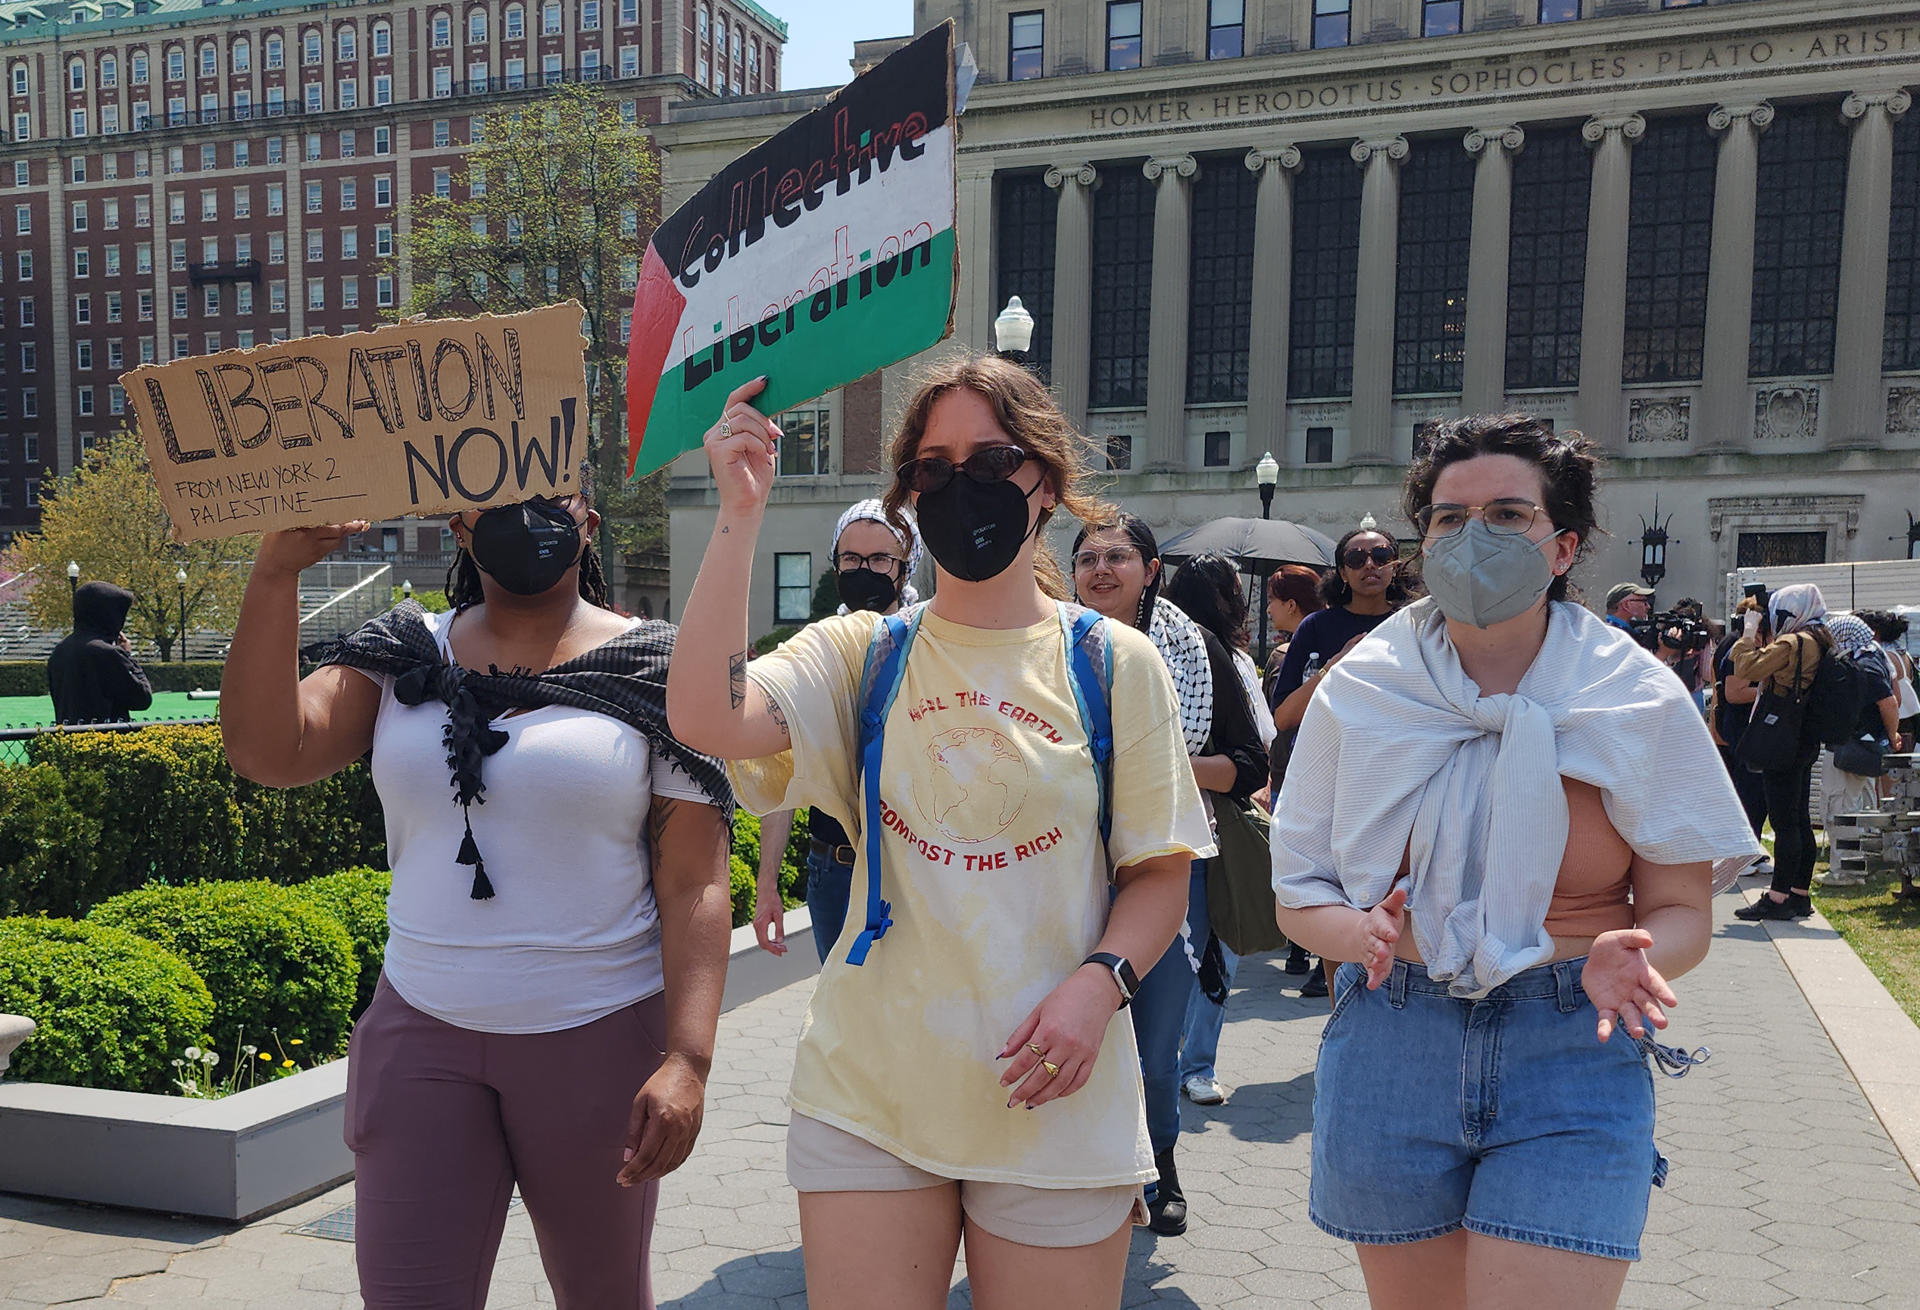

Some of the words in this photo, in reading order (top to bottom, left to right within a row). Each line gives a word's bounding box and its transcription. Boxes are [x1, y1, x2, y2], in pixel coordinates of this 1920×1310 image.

[1088, 101, 1193, 130] HOMER
[1213, 80, 1403, 118] HERODOTUS
[1430, 56, 1627, 97] SOPHOCLES
[1655, 41, 1774, 74] PLATO
[1804, 28, 1920, 60] ARIST
[678, 107, 929, 288] Collective
[682, 221, 933, 392] Liberation
[144, 328, 526, 465] LIBERATION
[175, 477, 223, 500] FROM
[227, 467, 270, 495] NEW
[272, 459, 319, 487] YORK
[325, 457, 341, 482] 2
[403, 397, 577, 504] NOW!
[955, 690, 991, 708] THE
[998, 700, 1063, 744] EARTH
[963, 851, 1009, 872] THE
[1014, 826, 1063, 862] RICH
